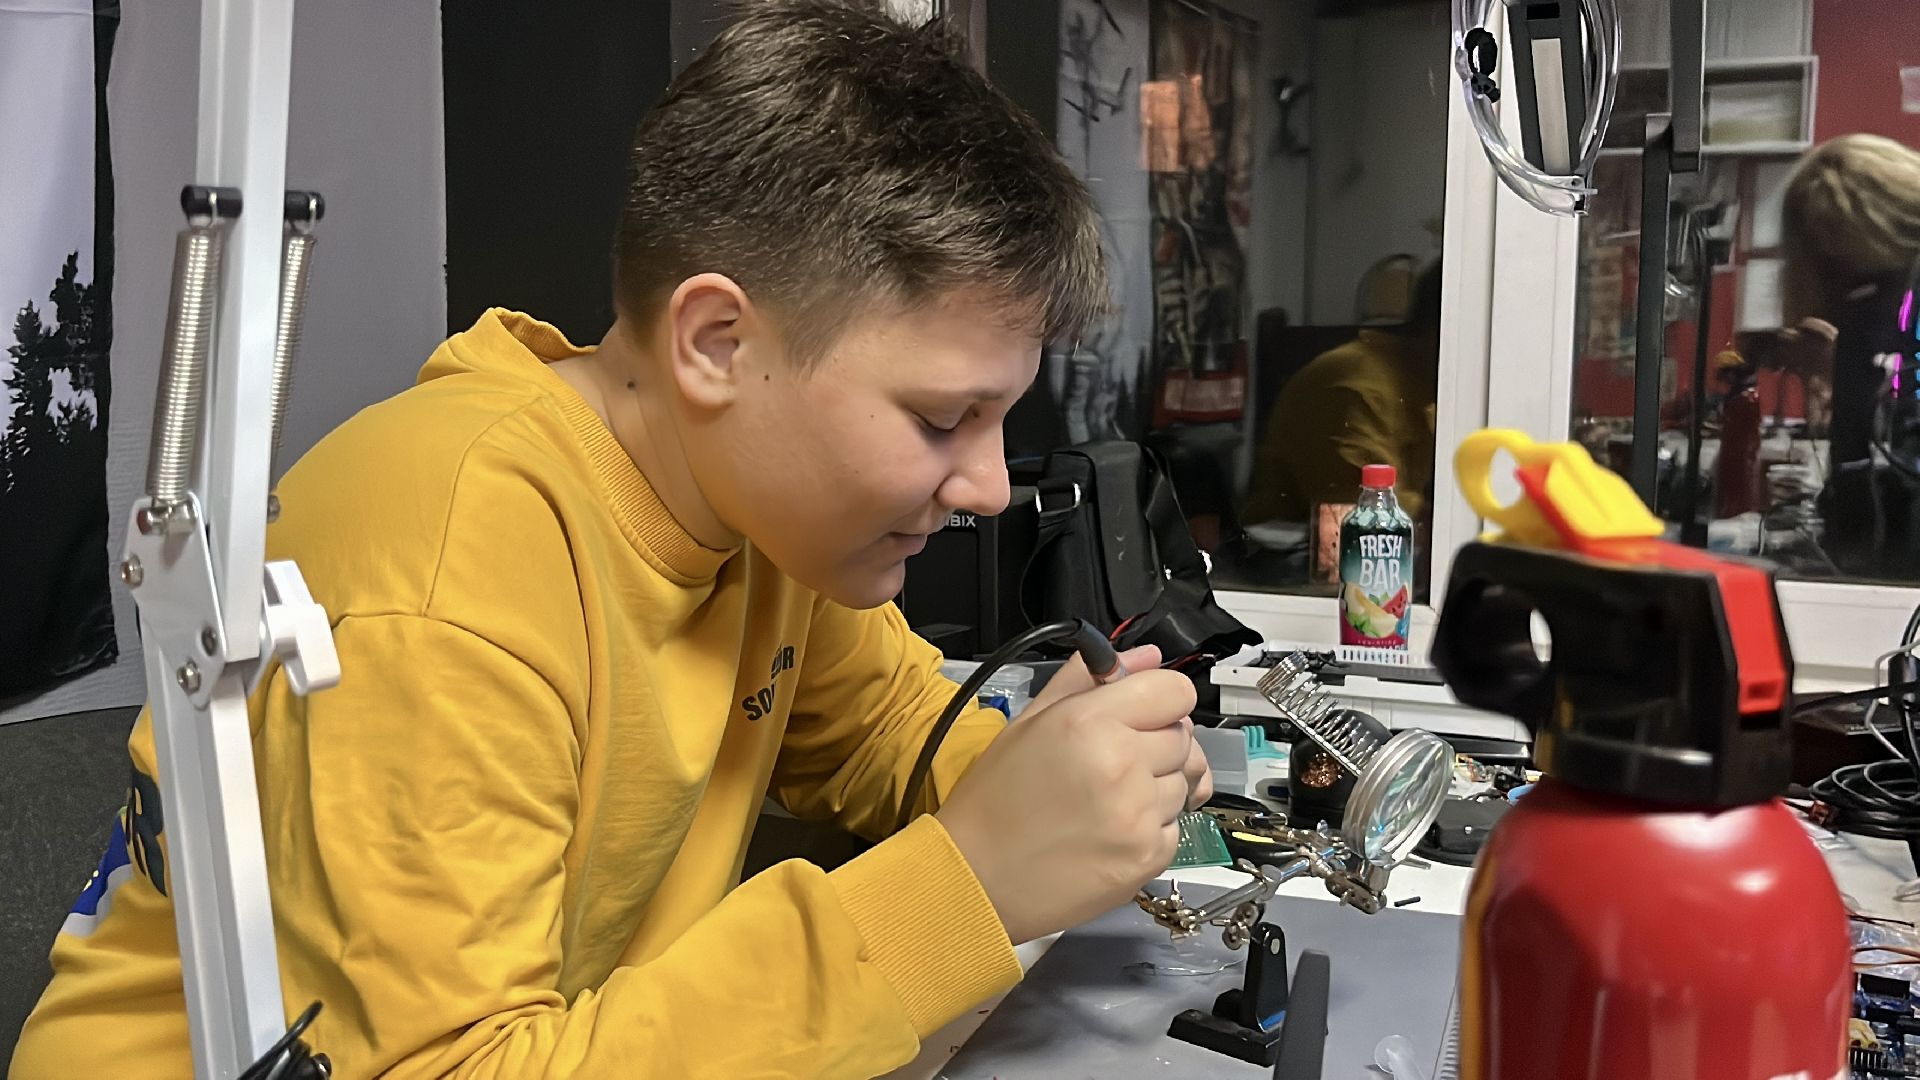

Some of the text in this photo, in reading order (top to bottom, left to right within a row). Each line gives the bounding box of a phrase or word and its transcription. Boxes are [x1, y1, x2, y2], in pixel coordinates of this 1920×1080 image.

[1359, 534, 1403, 558] FRESH
[1359, 558, 1400, 591] BAR
[742, 685, 775, 721] SO
